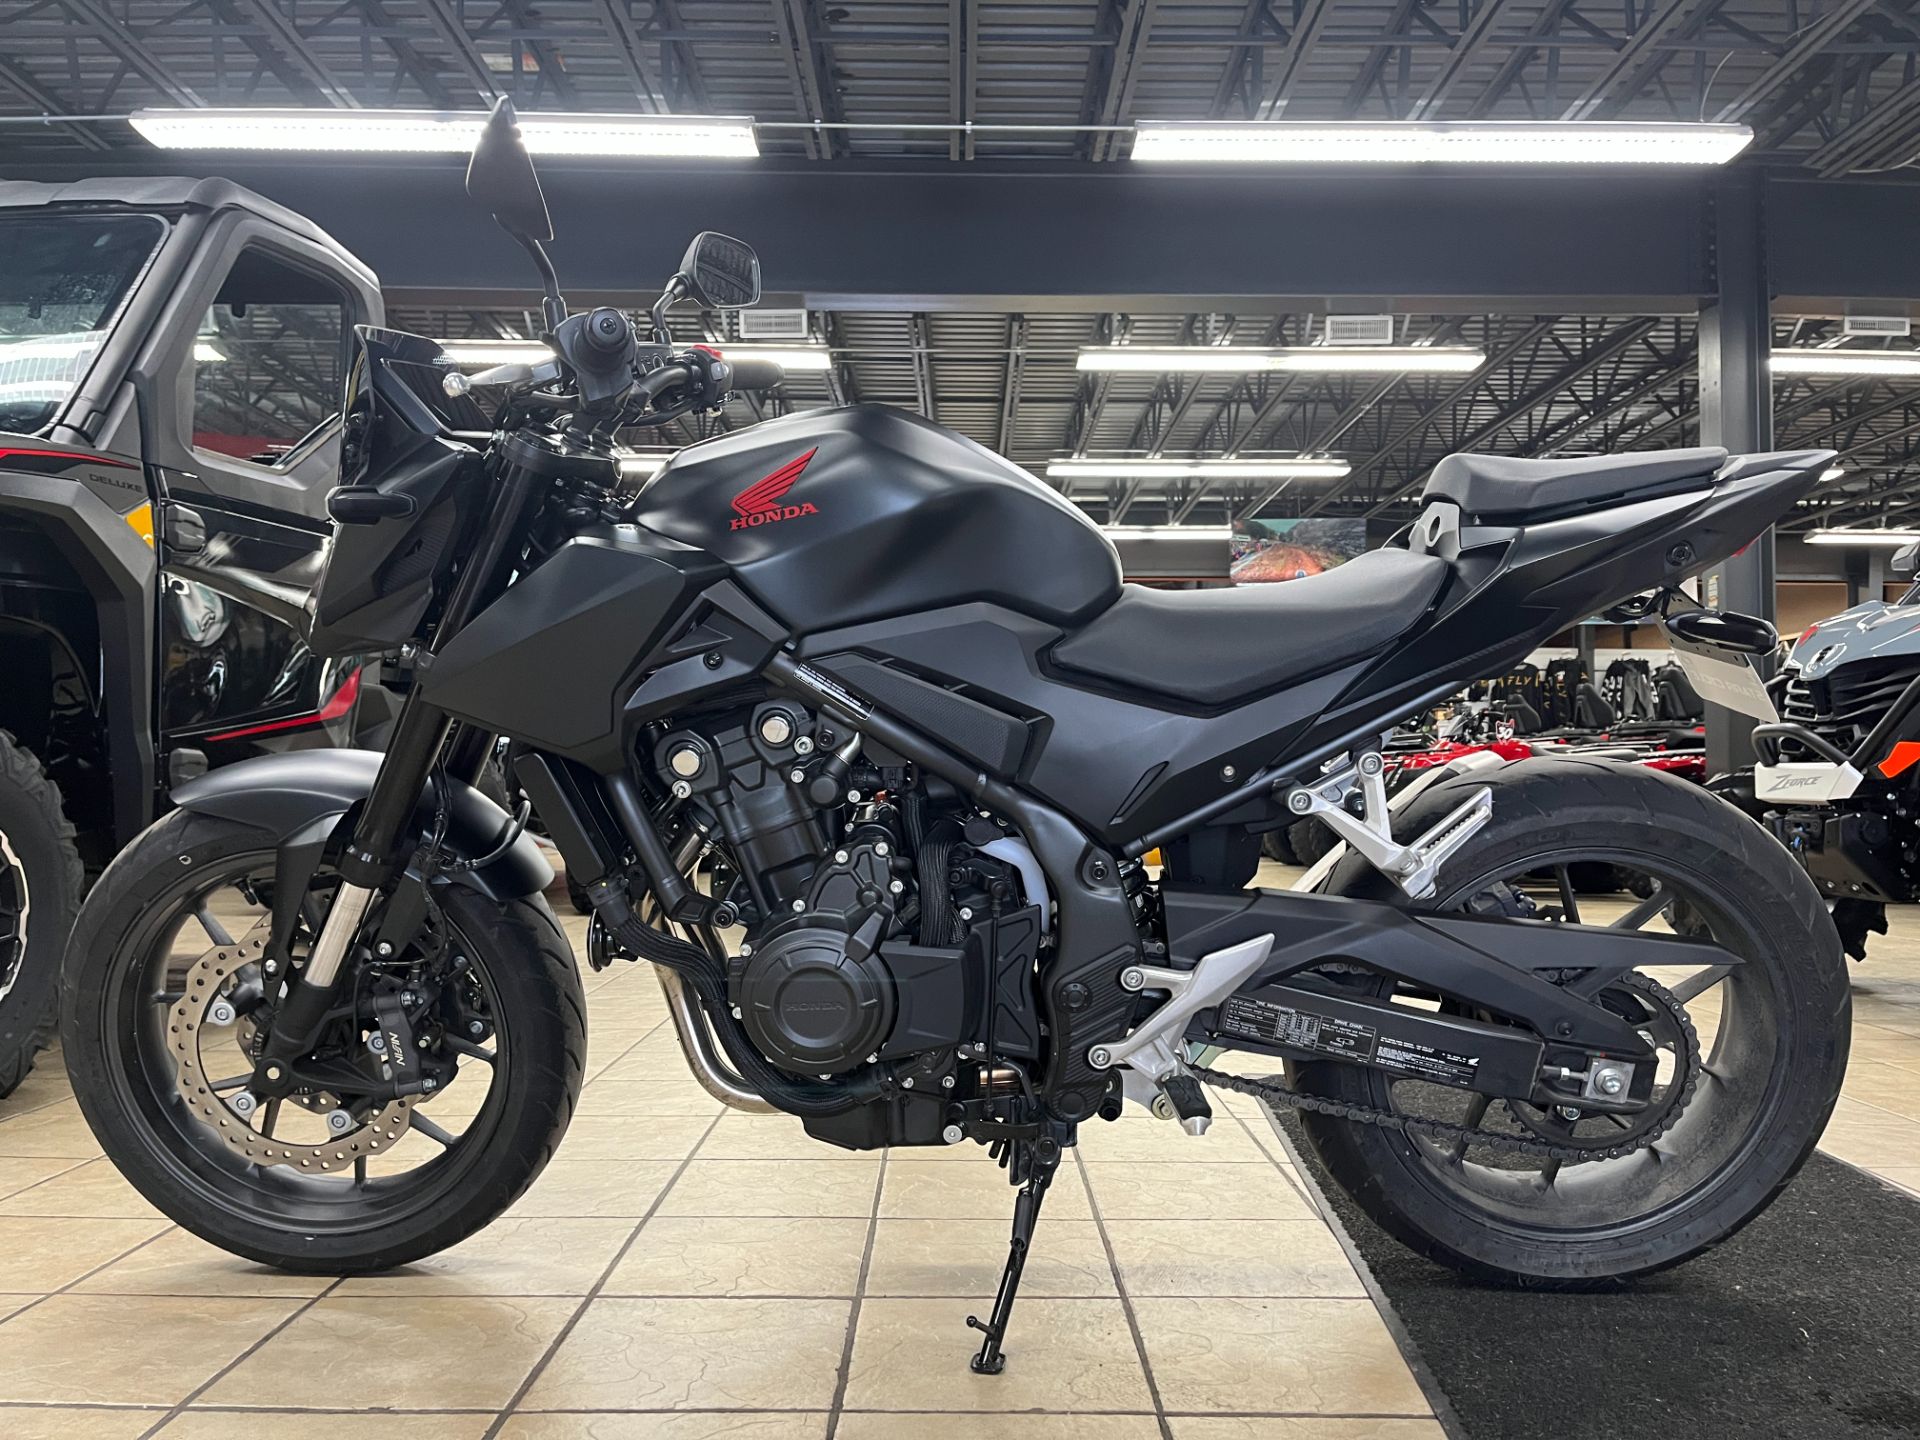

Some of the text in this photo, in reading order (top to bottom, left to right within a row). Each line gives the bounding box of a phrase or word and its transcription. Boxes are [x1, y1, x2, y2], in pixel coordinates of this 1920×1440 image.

[88, 473, 143, 493] DELUXE
[730, 503, 819, 531] HONDA
[1507, 675, 1532, 686] FLY
[785, 1002, 846, 1012] HONDA
[388, 1031, 406, 1066] NISSIN
